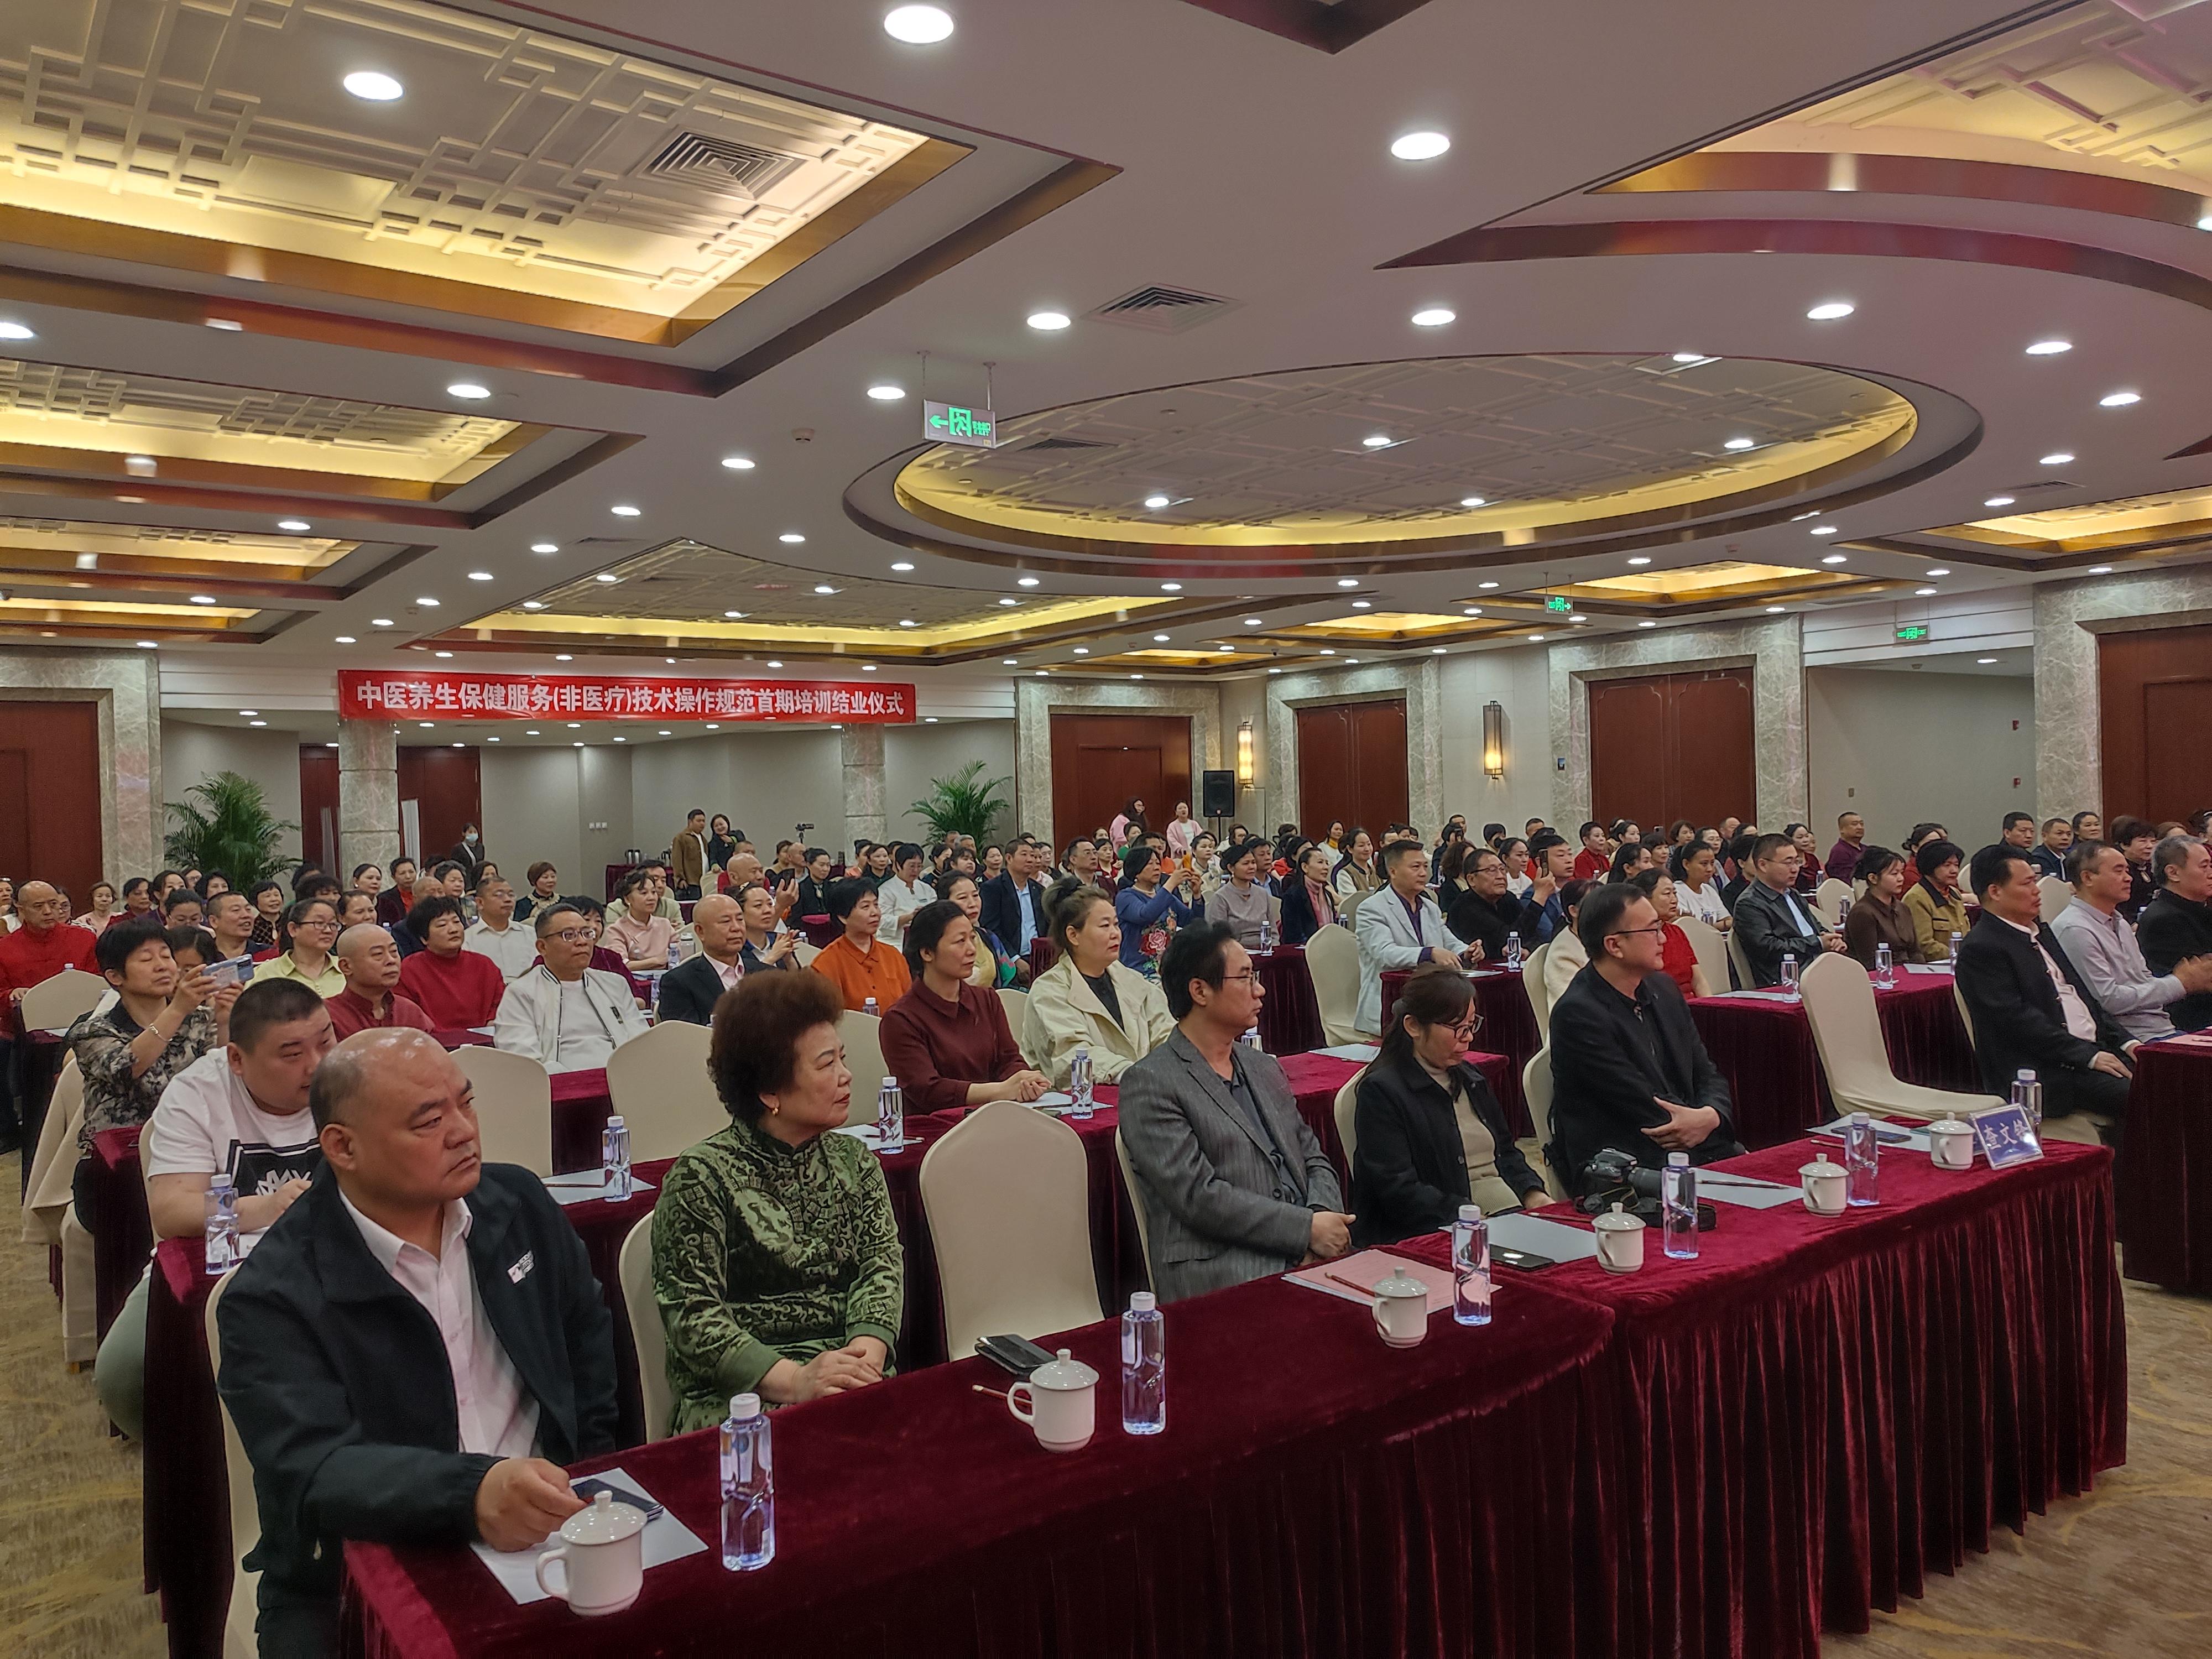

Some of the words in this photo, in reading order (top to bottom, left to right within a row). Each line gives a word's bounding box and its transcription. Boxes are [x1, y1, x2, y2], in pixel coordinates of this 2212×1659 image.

[357, 680, 905, 716] 中医养生保健服务(非医疗)技术操作规范首期培训结业仪式
